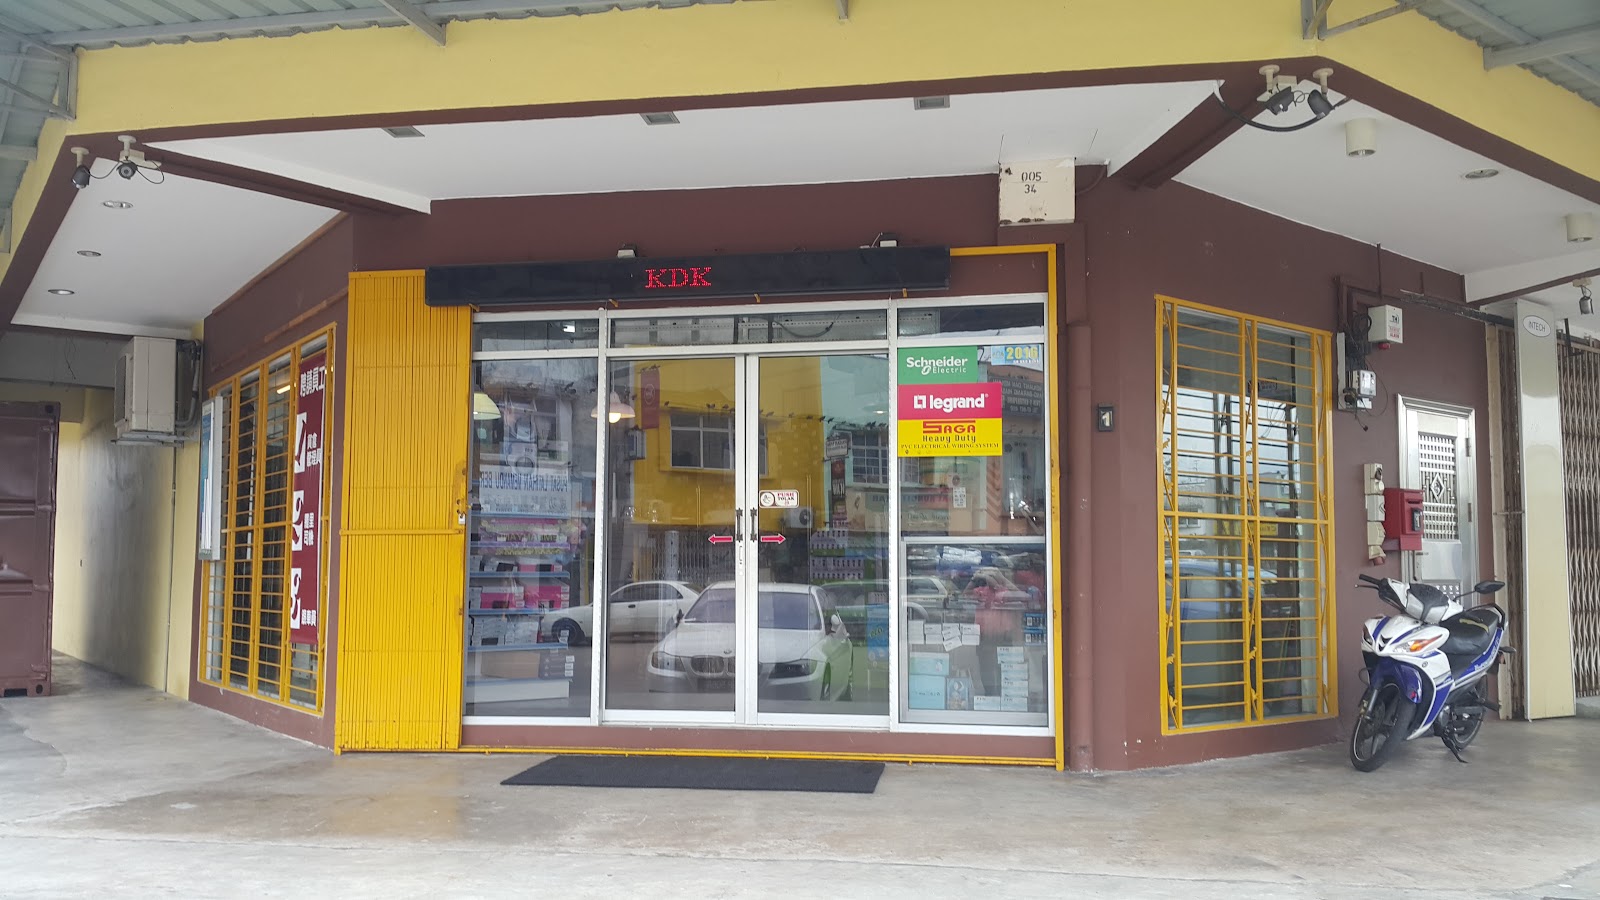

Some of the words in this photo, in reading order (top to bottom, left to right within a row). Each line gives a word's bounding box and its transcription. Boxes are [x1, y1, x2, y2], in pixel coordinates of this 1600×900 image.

[1021, 171, 1042, 182] 005
[1024, 183, 1037, 194] 34
[644, 266, 712, 289] KDK
[1528, 320, 1546, 333] INTECH
[1006, 346, 1039, 360] 2016
[906, 355, 969, 368] Schneider
[932, 366, 967, 374] Electric
[929, 393, 985, 413] legrand
[922, 420, 976, 434] SAGA
[922, 434, 951, 443] Heavy
[954, 434, 976, 443] Duty
